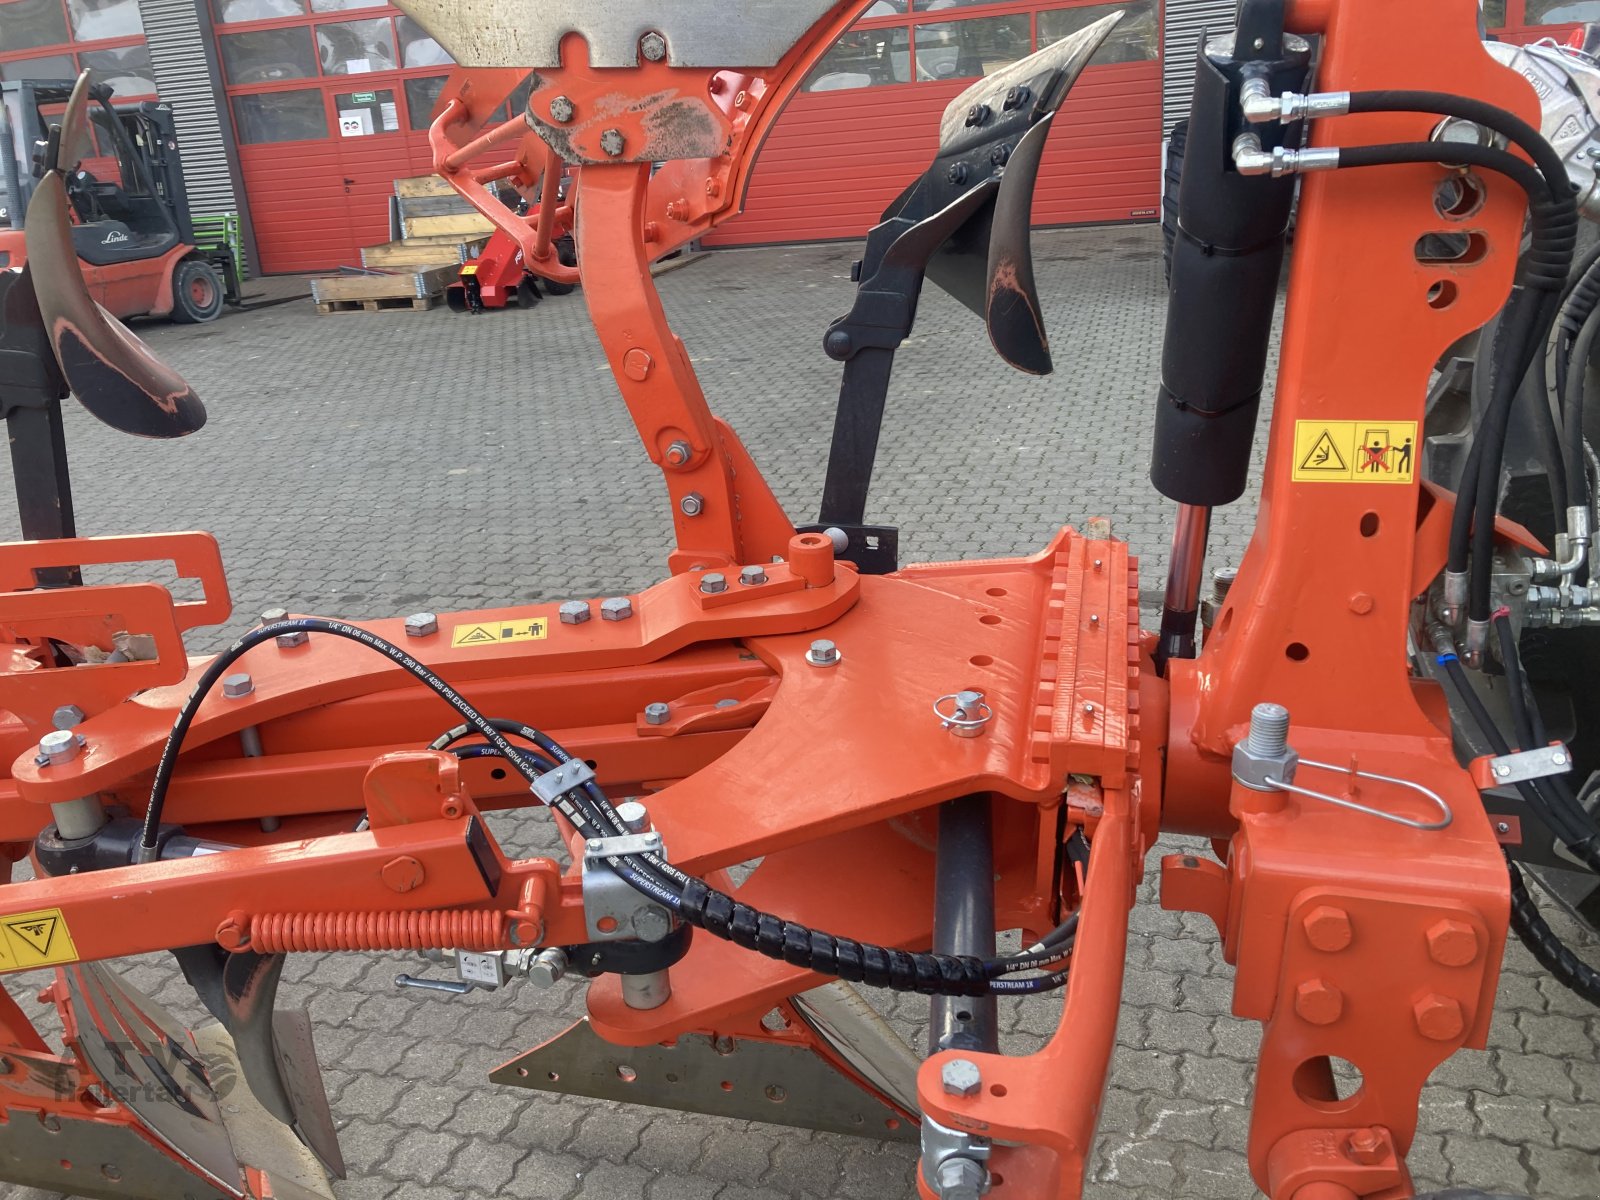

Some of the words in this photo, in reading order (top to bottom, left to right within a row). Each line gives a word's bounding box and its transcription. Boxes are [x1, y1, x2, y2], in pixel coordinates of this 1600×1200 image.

[101, 230, 128, 244] Linde
[256, 619, 297, 635] SUPERSTREAM
[341, 625, 352, 634] DN
[352, 629, 361, 637] 06
[360, 633, 373, 643] mm
[373, 638, 388, 652] Max.
[389, 647, 403, 661] W.P.
[403, 657, 415, 669] 290
[414, 665, 427, 677] Bar
[428, 676, 443, 690] 4205
[442, 687, 453, 700] PSI
[452, 695, 477, 720] EXCEED
[475, 717, 486, 728] EN
[483, 725, 496, 738] 857
[494, 735, 507, 749] 1SC
[504, 746, 522, 764] MSHA
[520, 726, 536, 740] SEL
[606, 809, 617, 821] DN
[615, 823, 625, 836] mm
[648, 853, 660, 866] Bar
[660, 862, 676, 877] 4205
[674, 870, 688, 883] PSI
[629, 872, 673, 903] SUPERSTREAM
[1019, 961, 1030, 971] DN
[1038, 957, 1050, 966] mm
